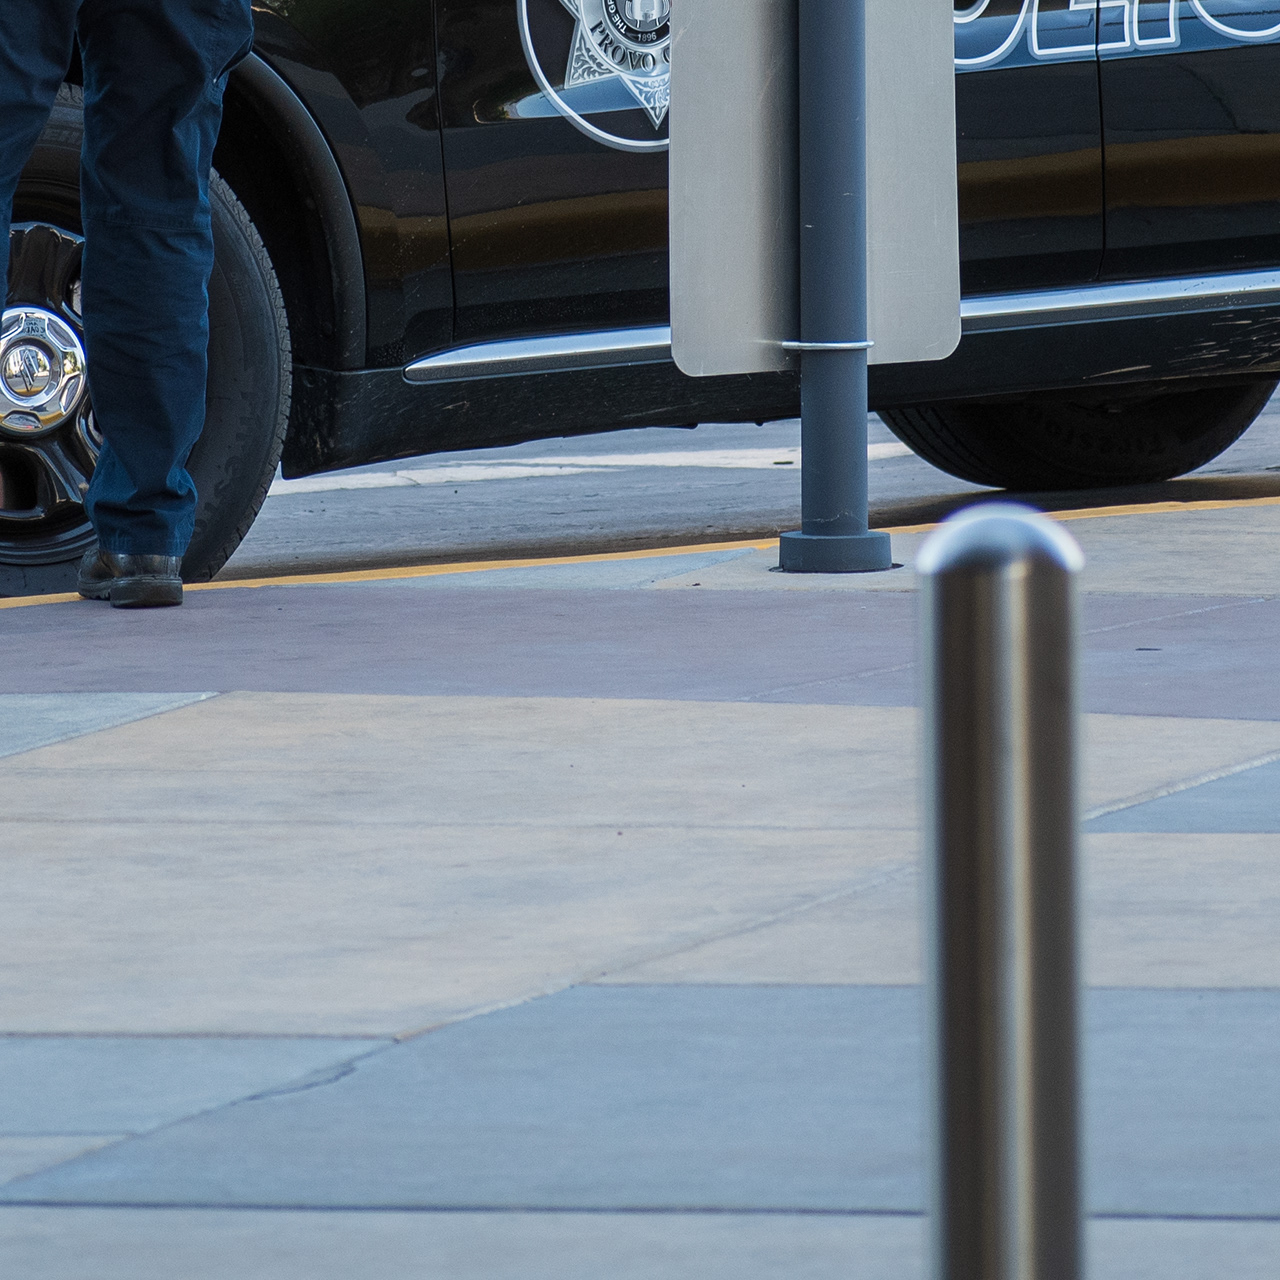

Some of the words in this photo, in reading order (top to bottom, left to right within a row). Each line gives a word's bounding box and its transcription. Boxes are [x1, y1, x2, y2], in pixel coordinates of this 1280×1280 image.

[611, 13, 628, 34] THE
[589, 19, 657, 73] PROVO
[637, 31, 658, 43] 1896
